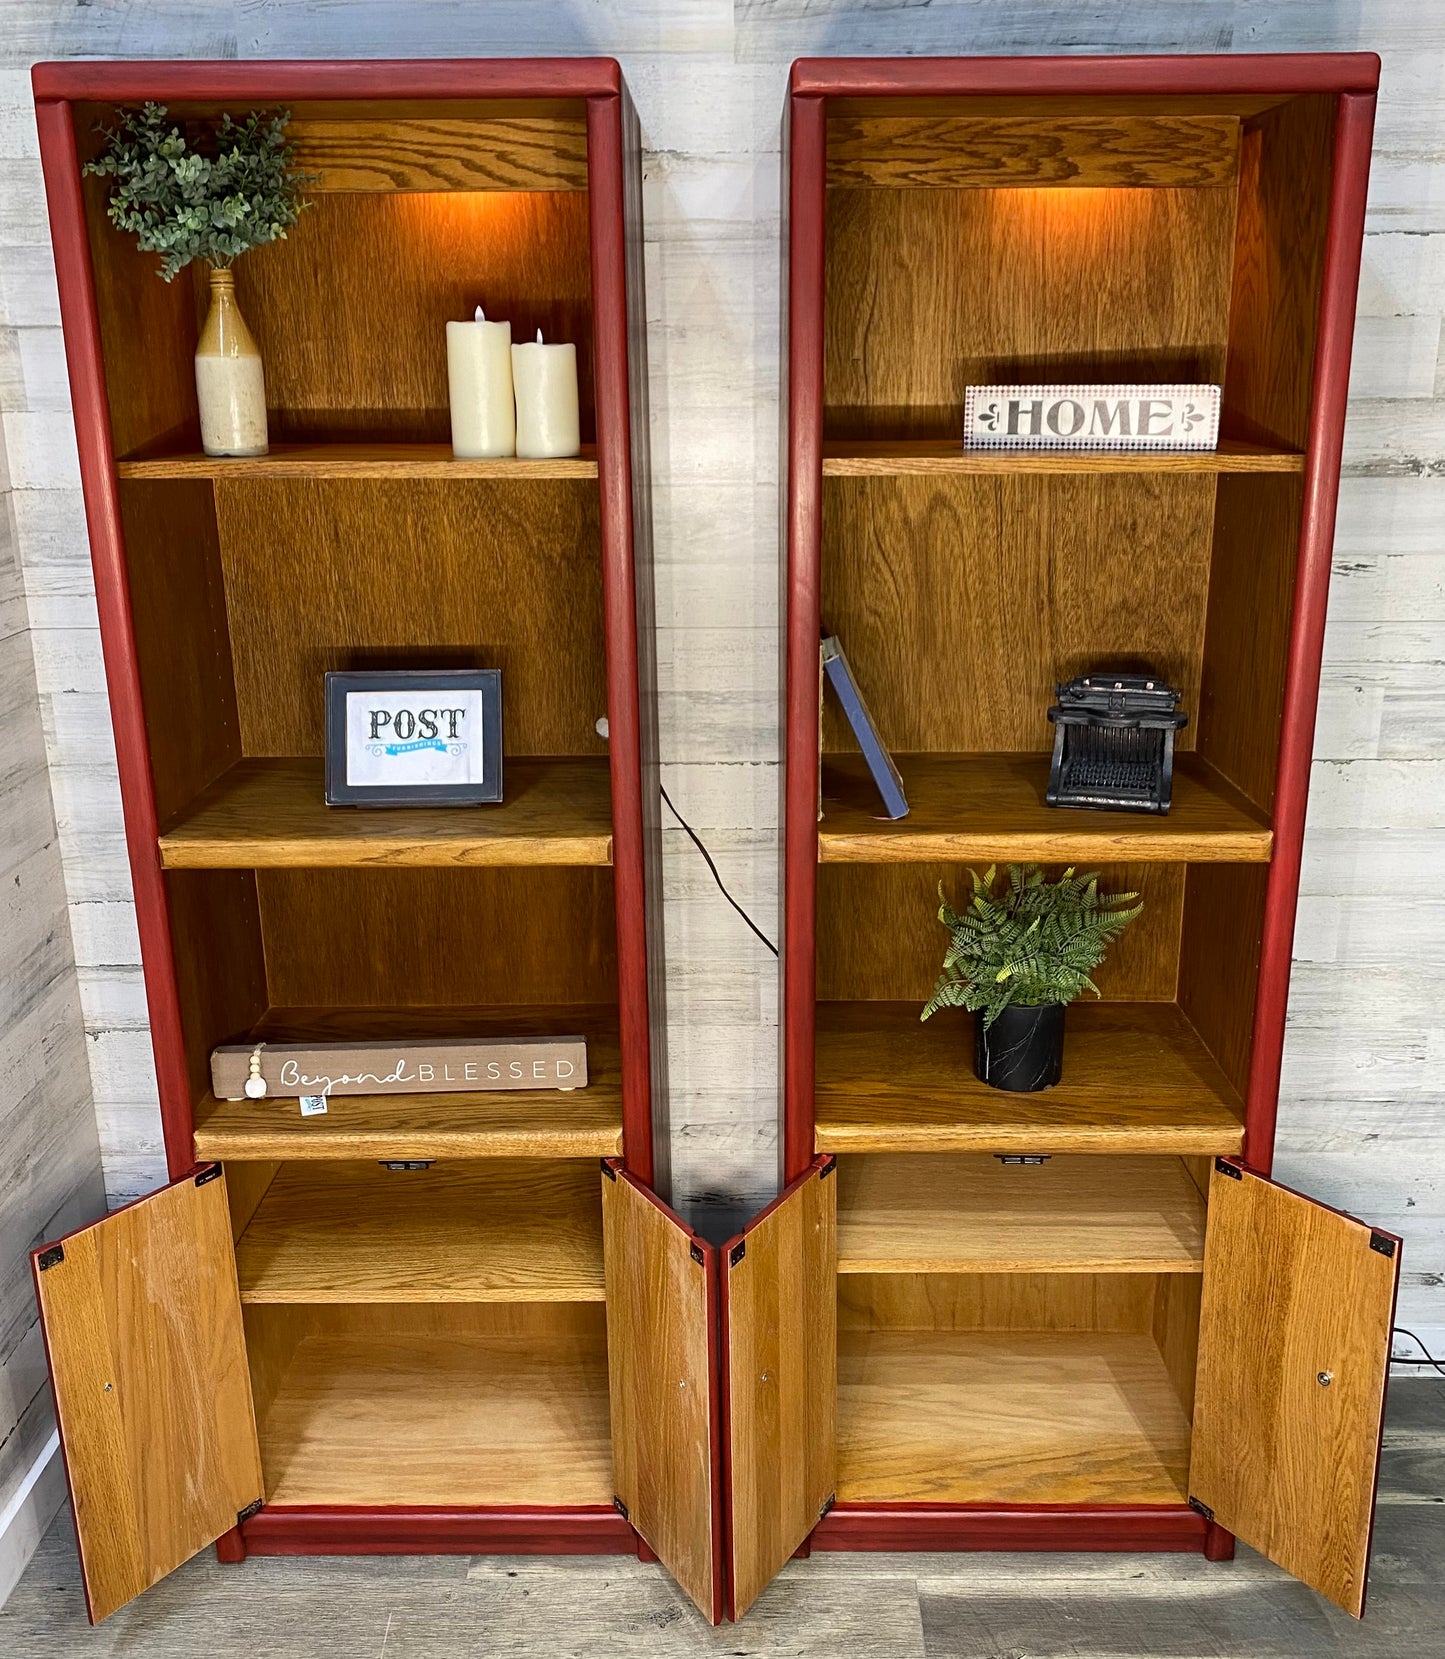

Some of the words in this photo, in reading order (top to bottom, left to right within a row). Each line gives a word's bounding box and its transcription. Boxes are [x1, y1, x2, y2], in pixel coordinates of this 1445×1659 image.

[1006, 400, 1174, 436] HOME
[368, 709, 466, 739] POST
[281, 1059, 416, 1095] Beyond
[419, 1060, 574, 1082] BLESSED
